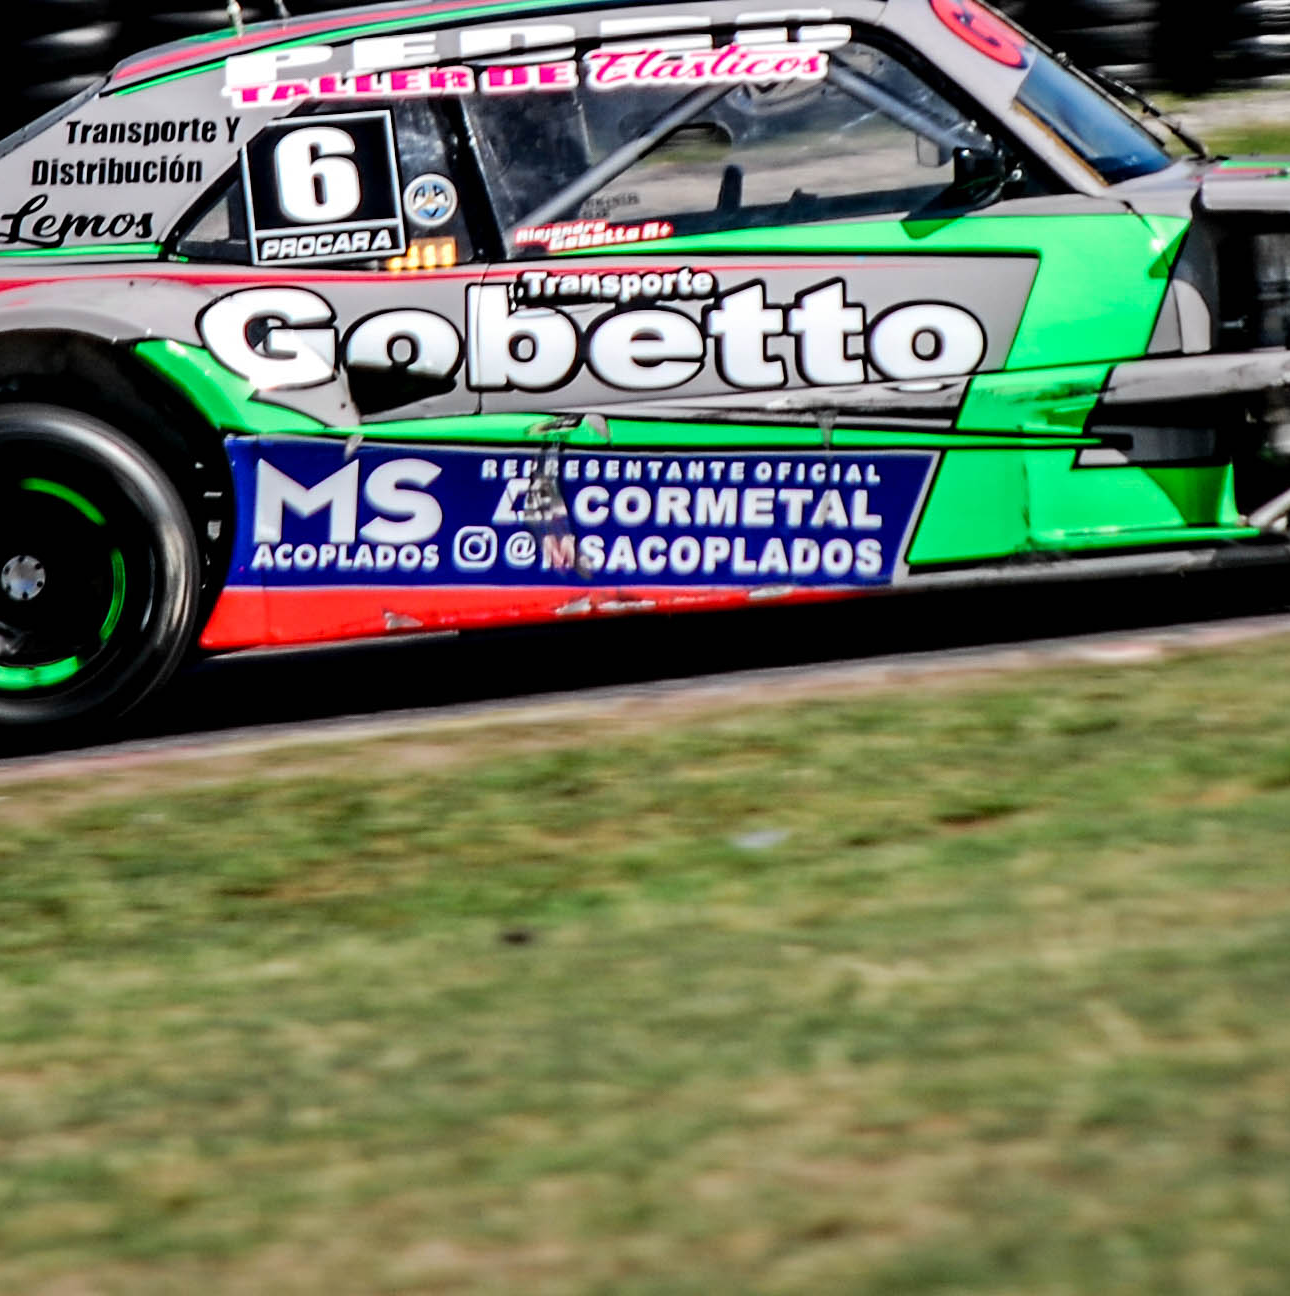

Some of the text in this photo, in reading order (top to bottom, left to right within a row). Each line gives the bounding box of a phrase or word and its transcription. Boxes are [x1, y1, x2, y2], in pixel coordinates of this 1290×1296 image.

[223, 66, 475, 107] TALLER
[481, 60, 577, 92] DE
[66, 116, 241, 146] Transporte Y
[31, 154, 202, 185] Distribución
[274, 126, 361, 224] 6
[521, 267, 713, 302] Transporte
[200, 278, 985, 392] Gobetto
[481, 458, 881, 484] REPRESENTANTE OFICIAL
[254, 458, 442, 544] MS
[574, 485, 883, 530] CORMETAL
[252, 544, 440, 570] ACOPLADOS
[505, 532, 883, 576] @MSACOPLADOS
